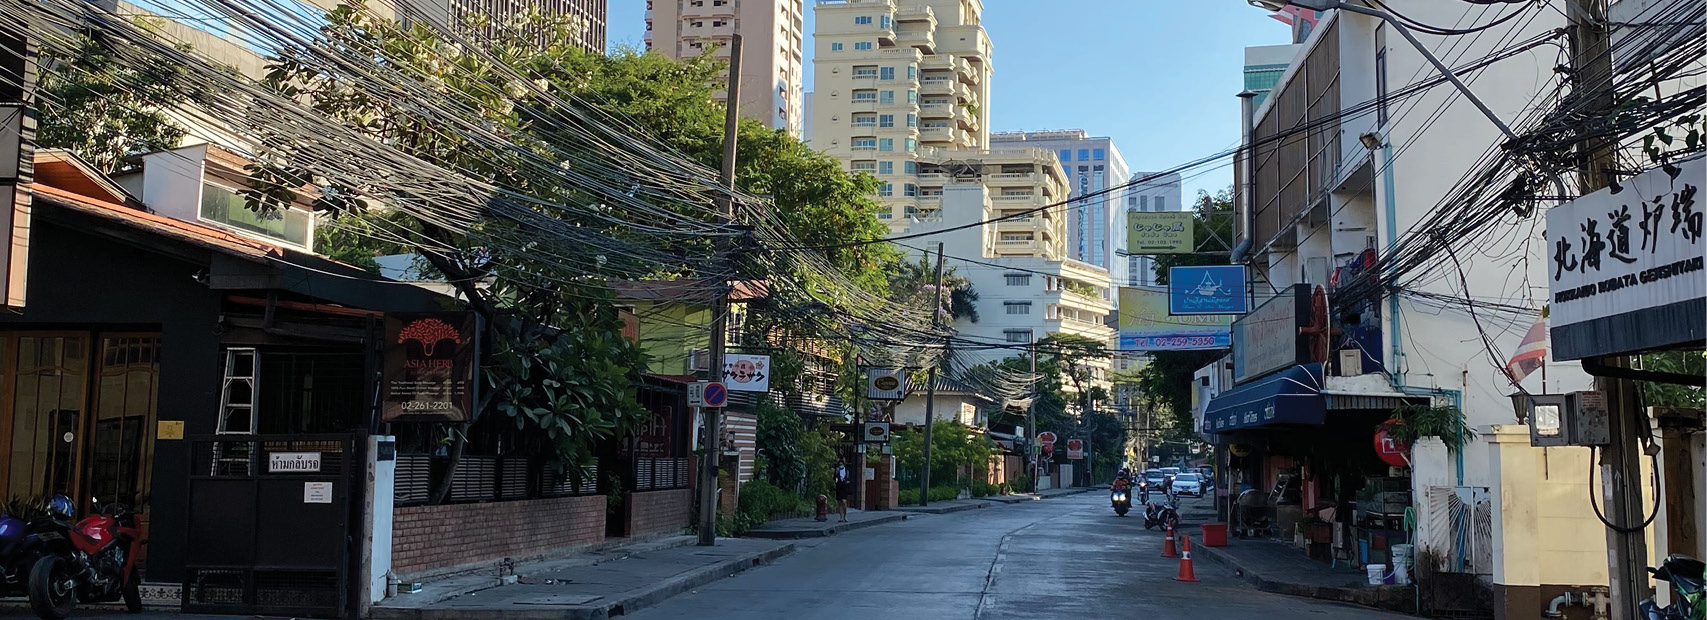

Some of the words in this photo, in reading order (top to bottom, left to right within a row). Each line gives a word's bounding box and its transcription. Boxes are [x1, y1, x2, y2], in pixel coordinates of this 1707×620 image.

[1135, 338, 1151, 348] Tel.
[403, 359, 427, 368] ASIA
[428, 359, 453, 368] HERB
[401, 401, 453, 411] 02-261-2201
[272, 455, 319, 470] ห้ามกลับรถ
